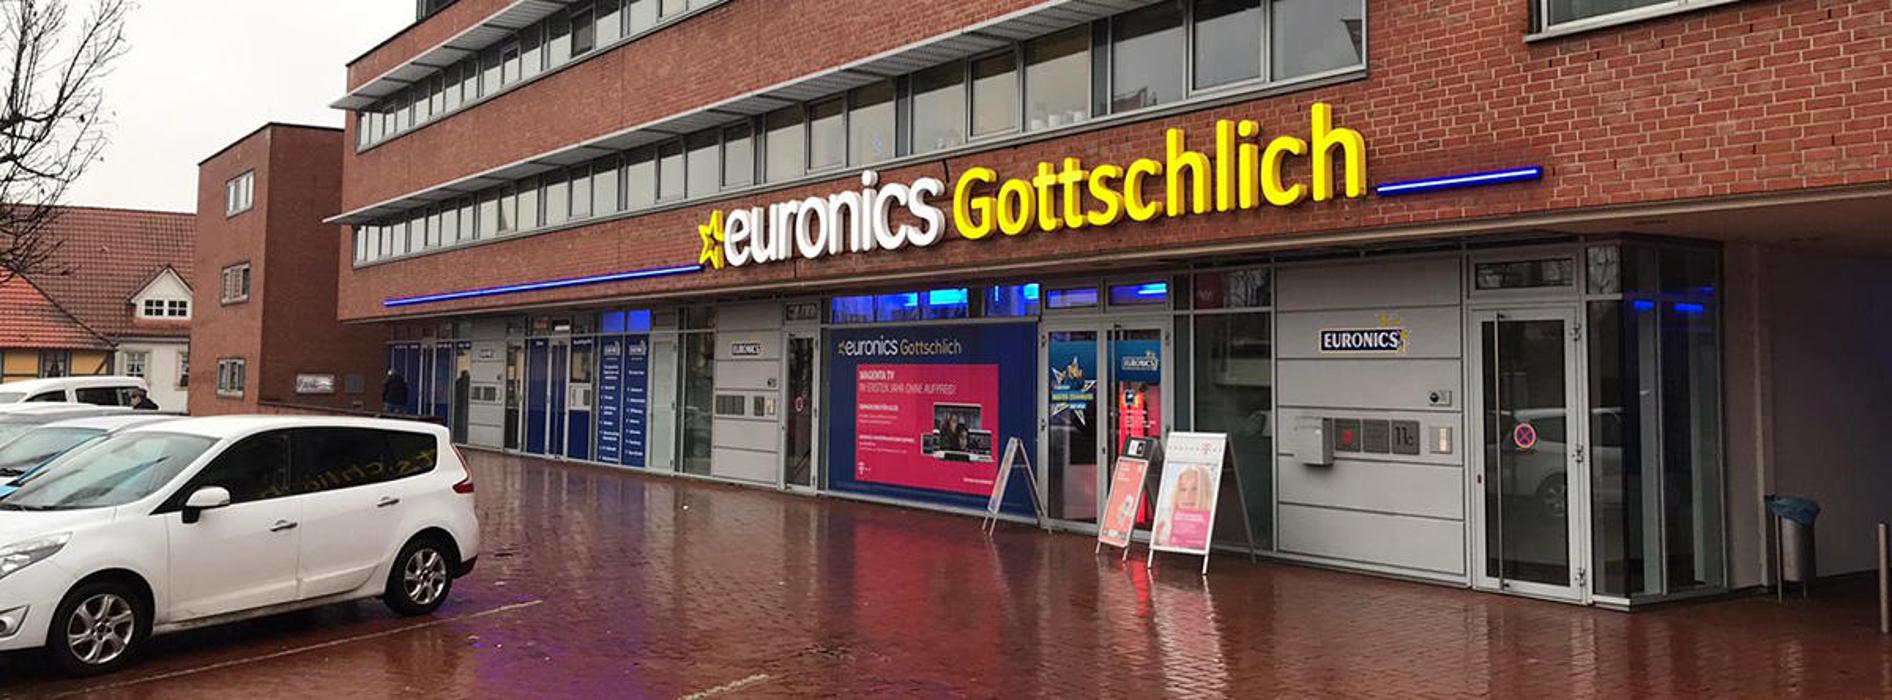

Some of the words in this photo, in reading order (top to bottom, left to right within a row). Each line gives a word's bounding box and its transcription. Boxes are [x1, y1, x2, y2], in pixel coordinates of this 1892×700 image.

[724, 170, 945, 268] euronics
[953, 102, 1367, 241] Gottschlich
[846, 335, 898, 356] euronics
[900, 338, 962, 355] Gottschlich
[1324, 332, 1398, 348] EURONICS
